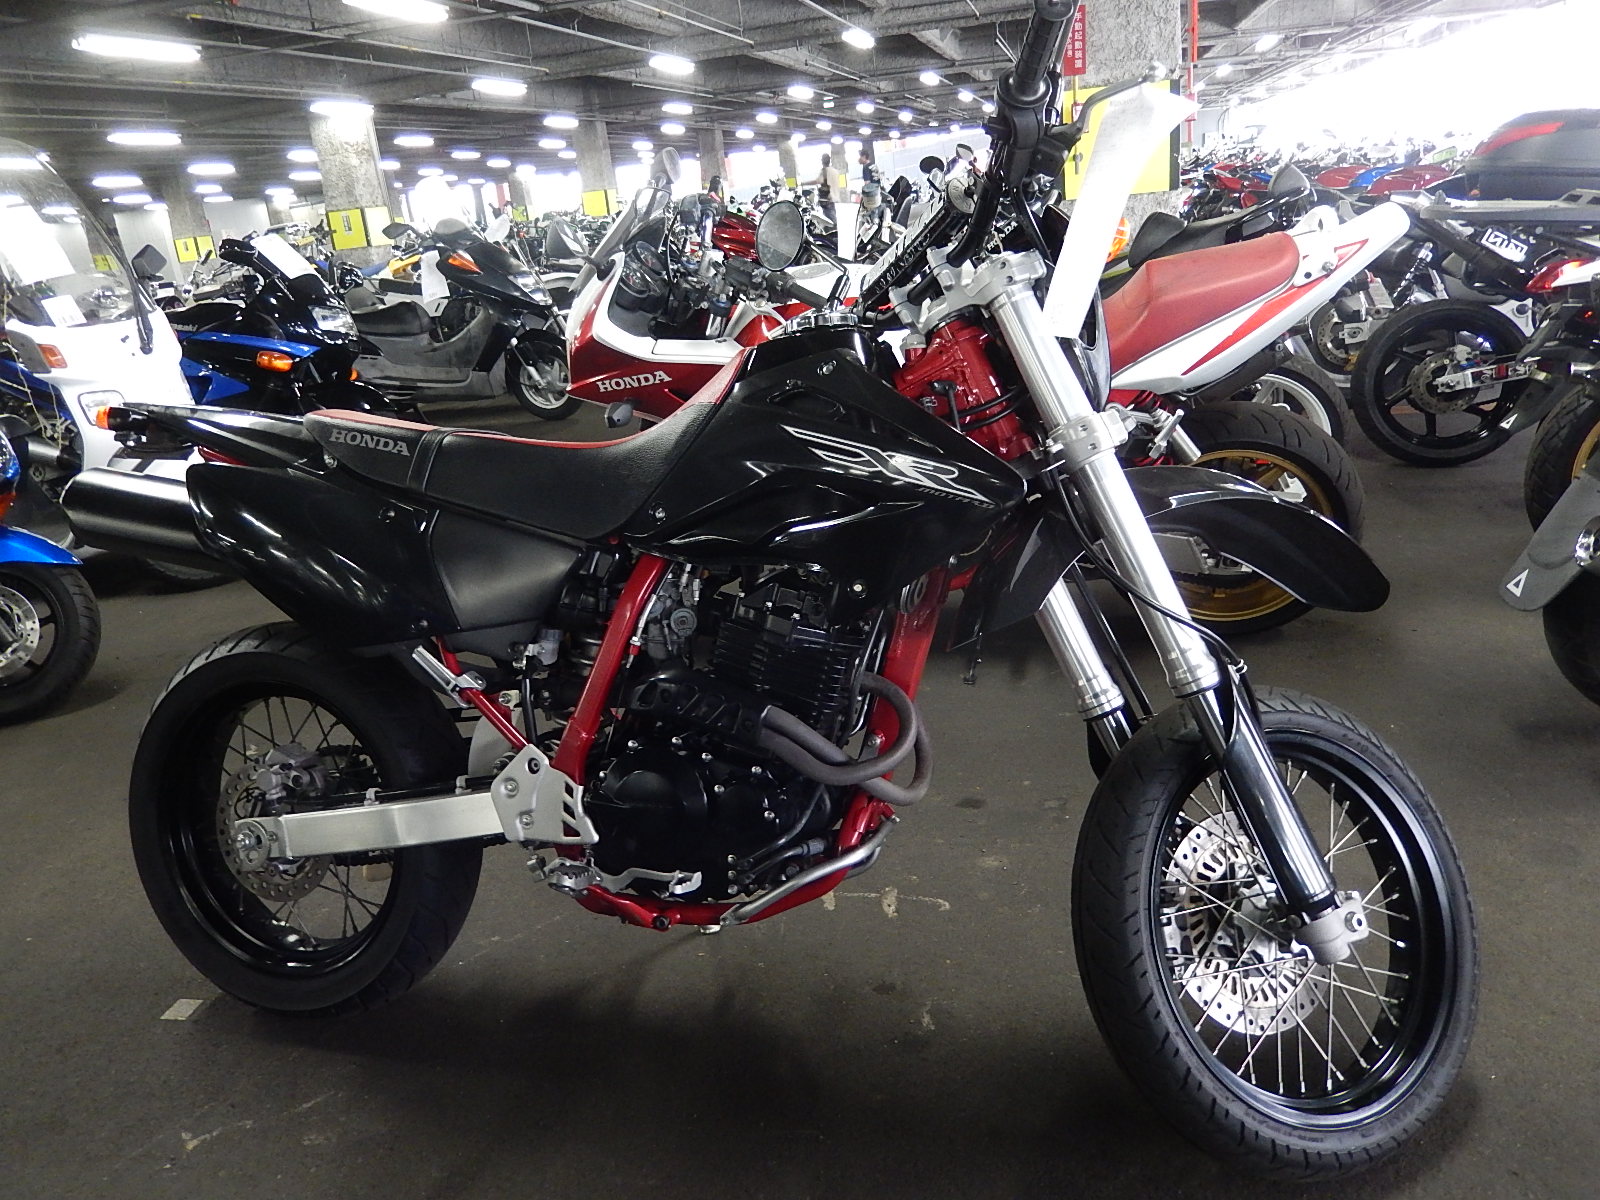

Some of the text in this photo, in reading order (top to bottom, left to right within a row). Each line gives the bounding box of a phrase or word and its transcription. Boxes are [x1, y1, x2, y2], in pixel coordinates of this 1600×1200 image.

[596, 370, 672, 392] HONDA
[329, 429, 410, 457] HONDA
[778, 423, 997, 505] XR
